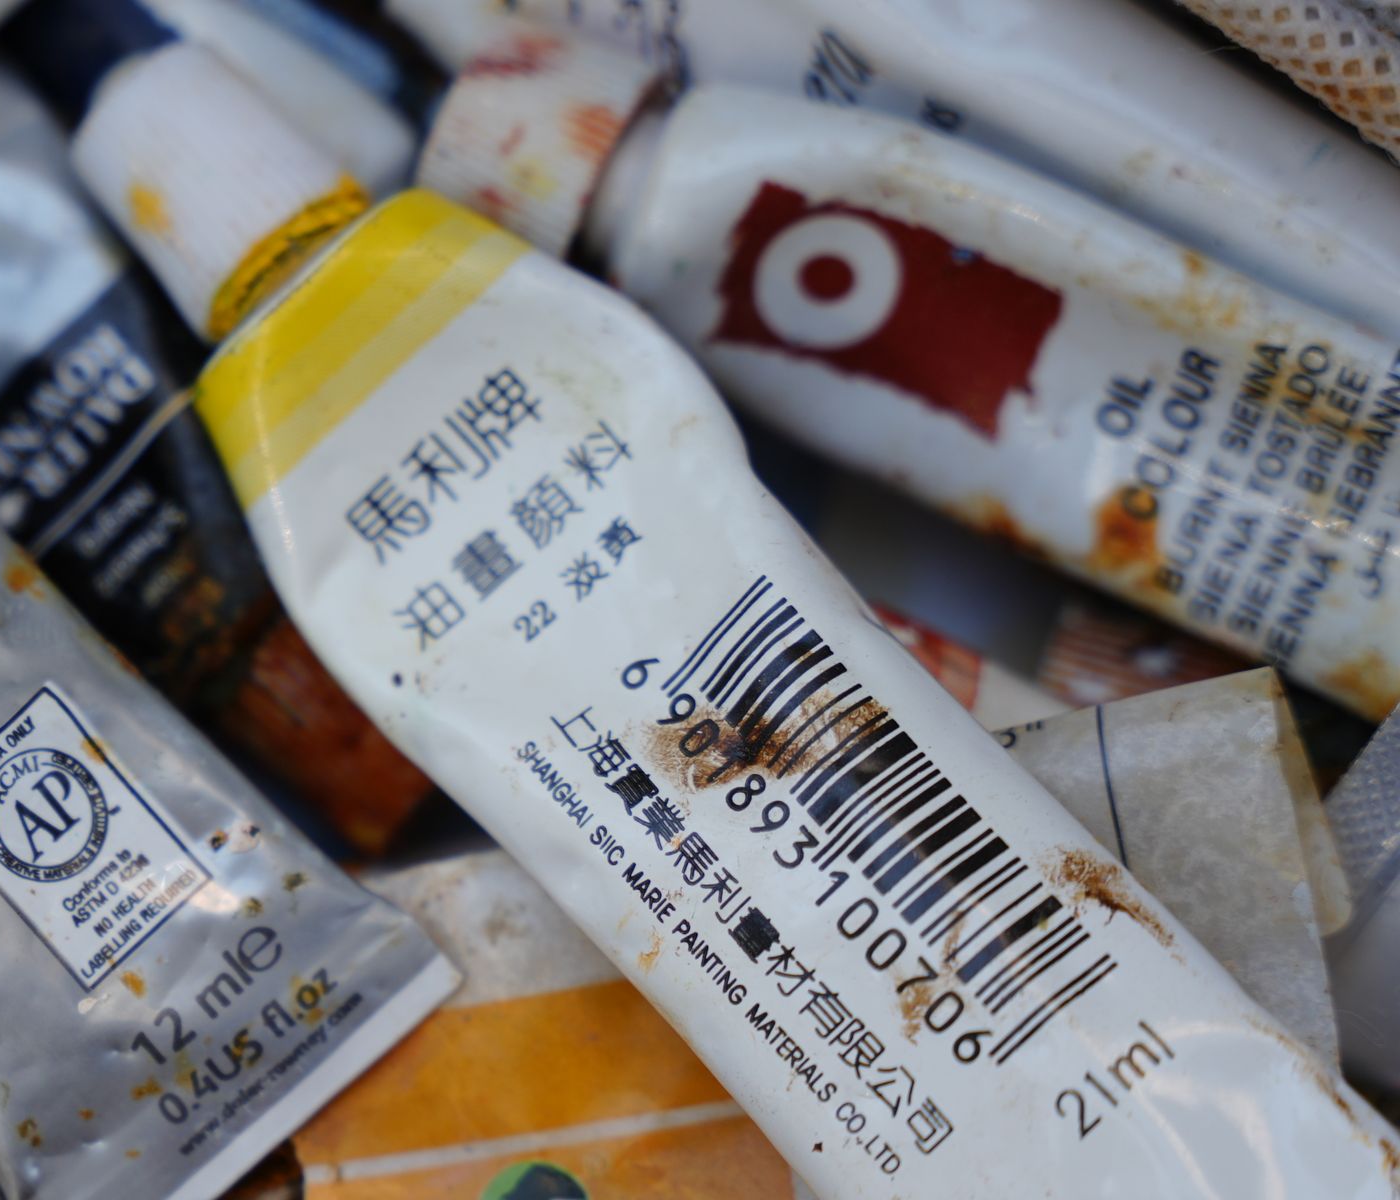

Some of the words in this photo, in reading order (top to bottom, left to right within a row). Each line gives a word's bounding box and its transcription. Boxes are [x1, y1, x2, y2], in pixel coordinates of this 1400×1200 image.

[1098, 373, 1155, 438] OIL
[1120, 347, 1220, 520] COLOUR
[1248, 344, 1330, 496] TOSTADO
[345, 367, 543, 566] 馬利牌
[1153, 458, 1236, 596] BURNT
[1219, 341, 1288, 452] SIENNA
[513, 600, 558, 642] 22
[5, 716, 36, 749] ONLY
[15, 770, 82, 863] AP
[62, 861, 119, 912] Conforms
[72, 891, 109, 928] ASTM
[105, 881, 119, 896] D
[93, 917, 114, 938] NO
[111, 878, 157, 920] HEALTH
[81, 919, 143, 979] LABELLING
[516, 741, 592, 829] SHANGHAI
[589, 824, 626, 868] SIIC
[621, 862, 676, 925] MARIE
[671, 918, 748, 1007] PAINTING
[744, 1003, 839, 1103] MATERIALS
[131, 1007, 197, 1065] 12
